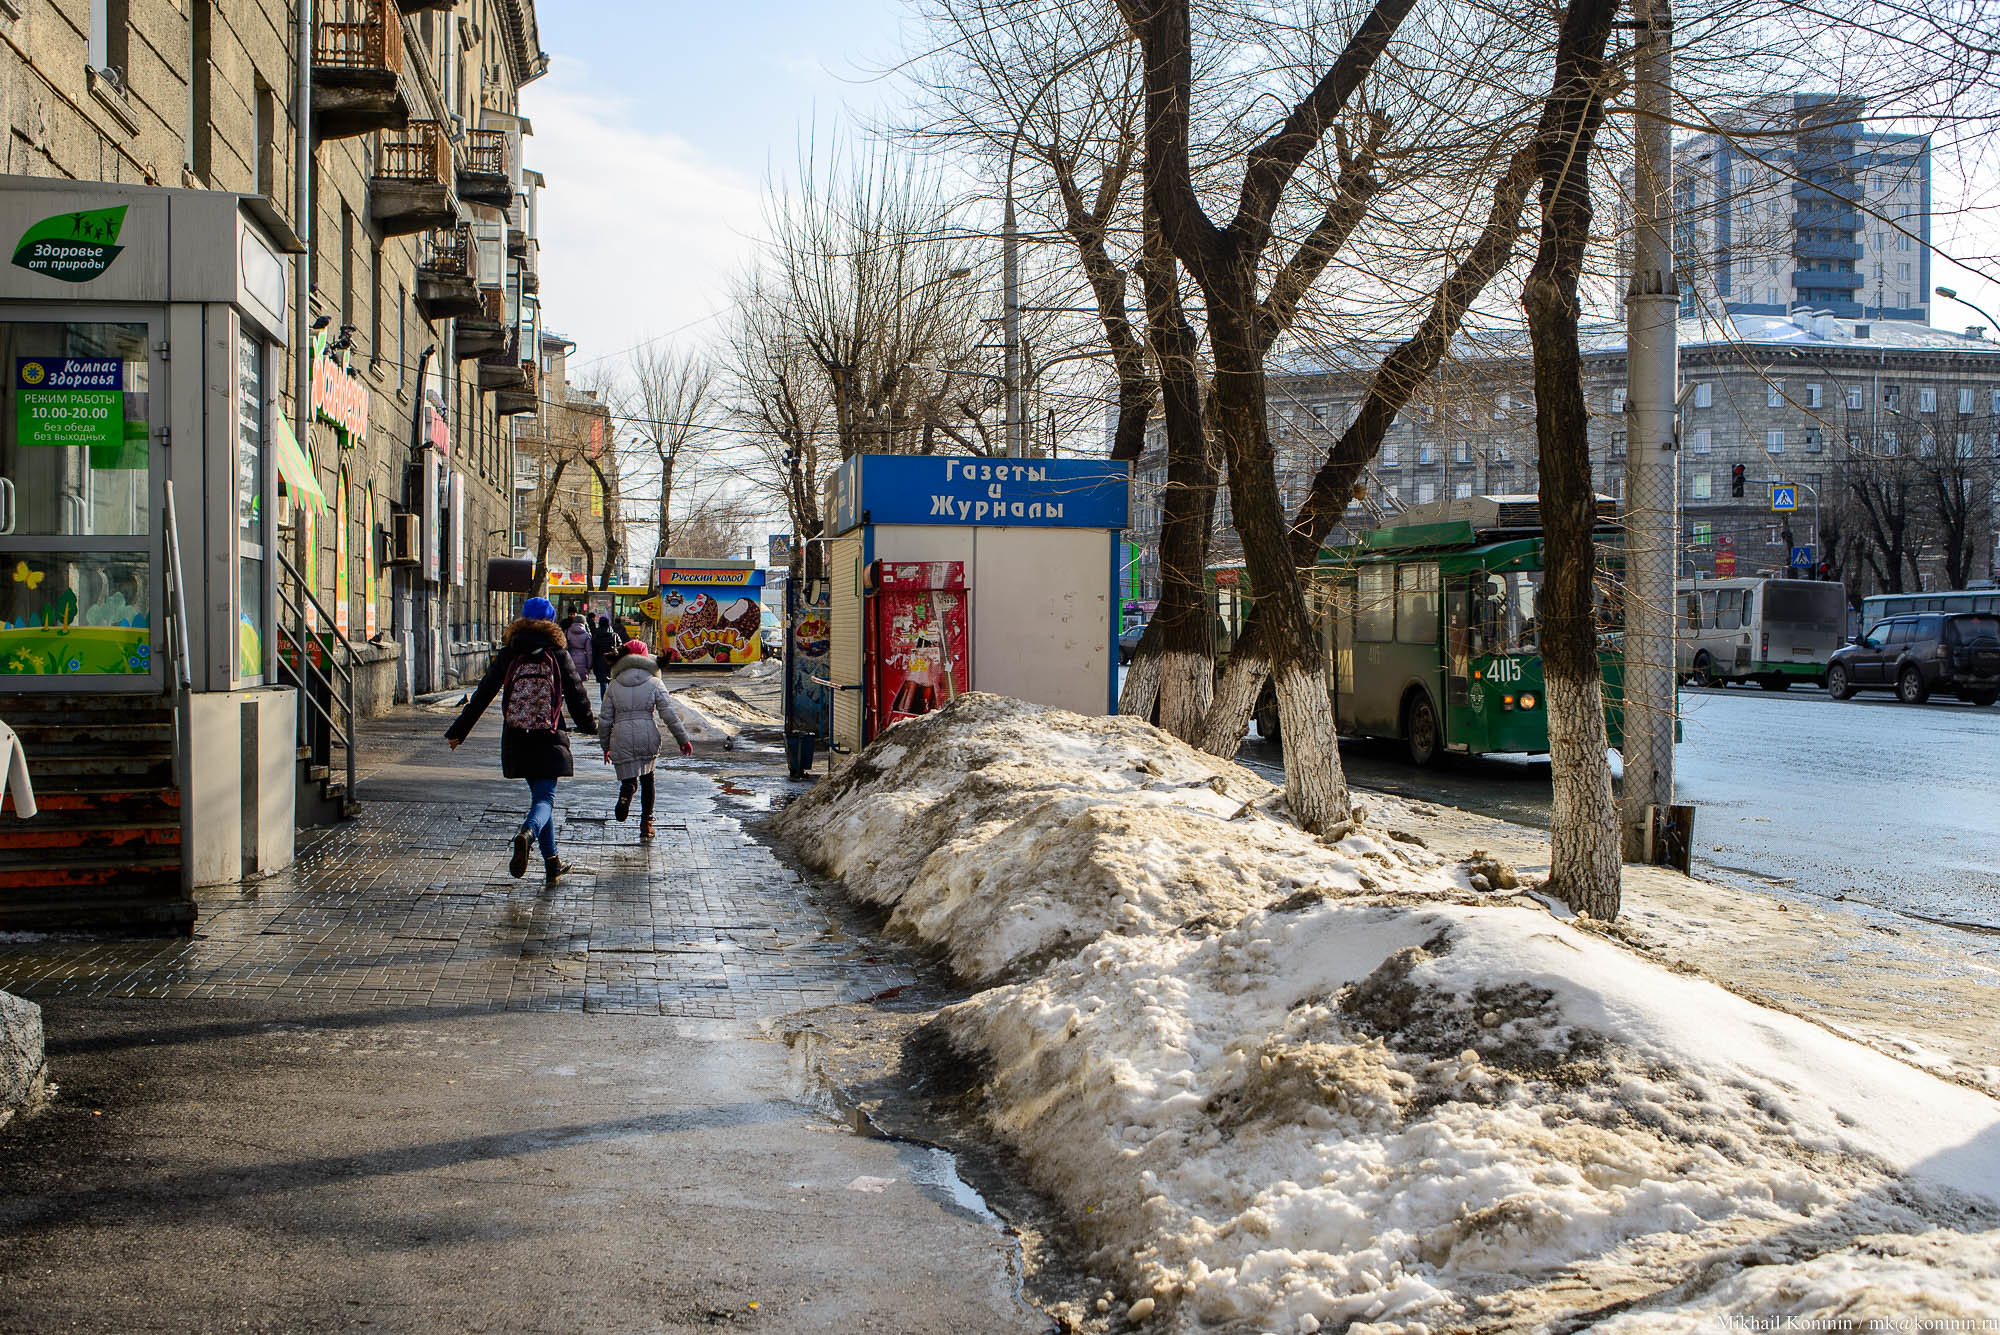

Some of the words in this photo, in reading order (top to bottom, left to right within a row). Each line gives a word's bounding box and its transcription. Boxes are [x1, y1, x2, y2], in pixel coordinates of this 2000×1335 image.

[33, 244, 104, 259] Здоровье
[28, 260, 47, 269] от
[51, 258, 105, 271] природы
[64, 360, 117, 373] Компас
[48, 372, 115, 388] Здоровья
[24, 393, 67, 404] РЕЖИМ
[70, 394, 115, 405] РАБОТЫ
[31, 407, 108, 419] 10.00-20.00
[43, 422, 62, 432] без
[64, 422, 96, 433] обеда
[33, 431, 52, 441] без
[54, 433, 106, 443] выходных
[946, 459, 1046, 482] Газеты
[987, 483, 1002, 498] и
[930, 495, 1063, 520] Журналы
[671, 571, 713, 583] Русский
[715, 572, 744, 583] холод
[1486, 658, 1521, 682] 4115
